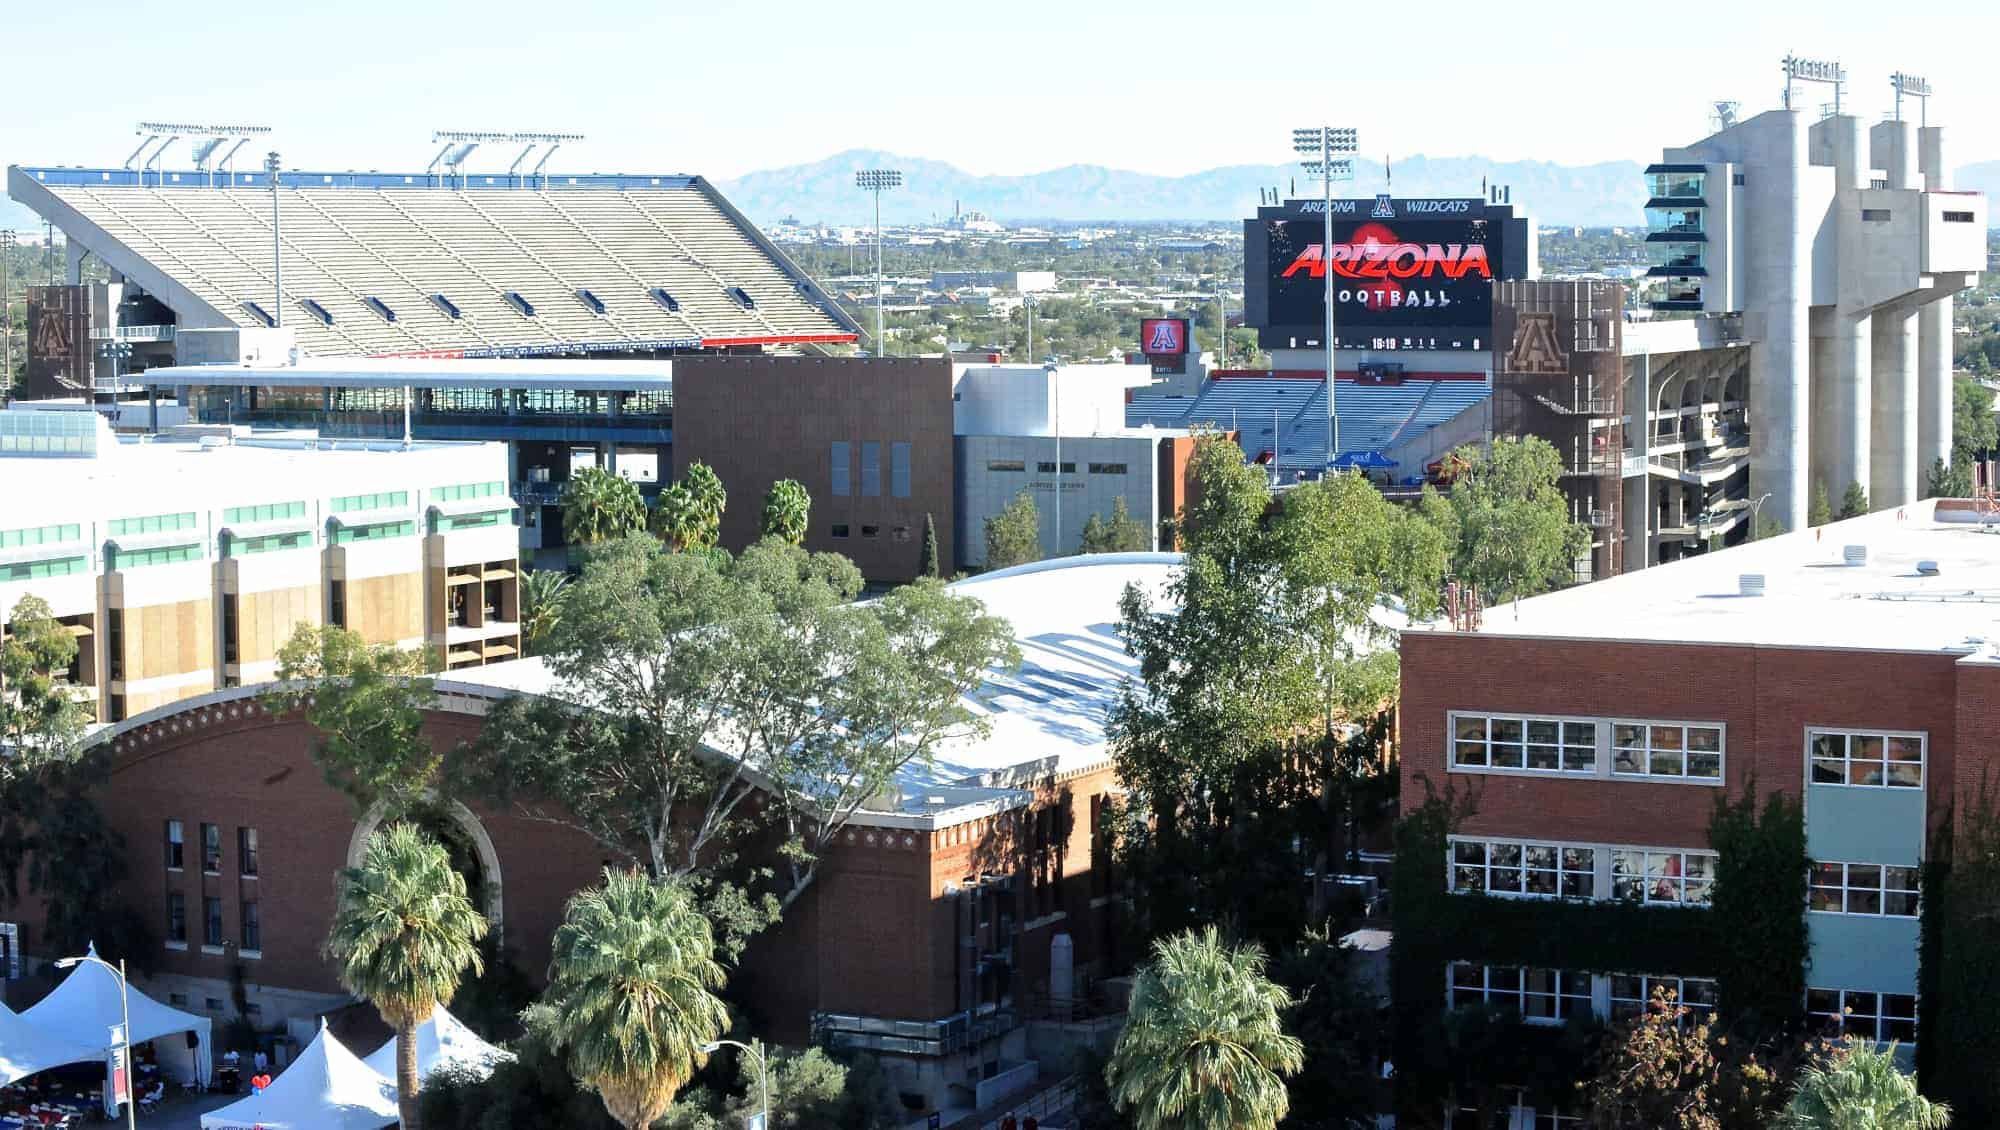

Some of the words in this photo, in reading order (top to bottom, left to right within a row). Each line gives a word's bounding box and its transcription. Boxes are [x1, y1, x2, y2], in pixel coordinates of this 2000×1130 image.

[1371, 195, 1395, 218] A
[1406, 200, 1470, 213] WILDCATS
[1281, 243, 1492, 279] ARIZONA
[1323, 290, 1451, 307] OOTBALL
[1152, 323, 1176, 349] A
